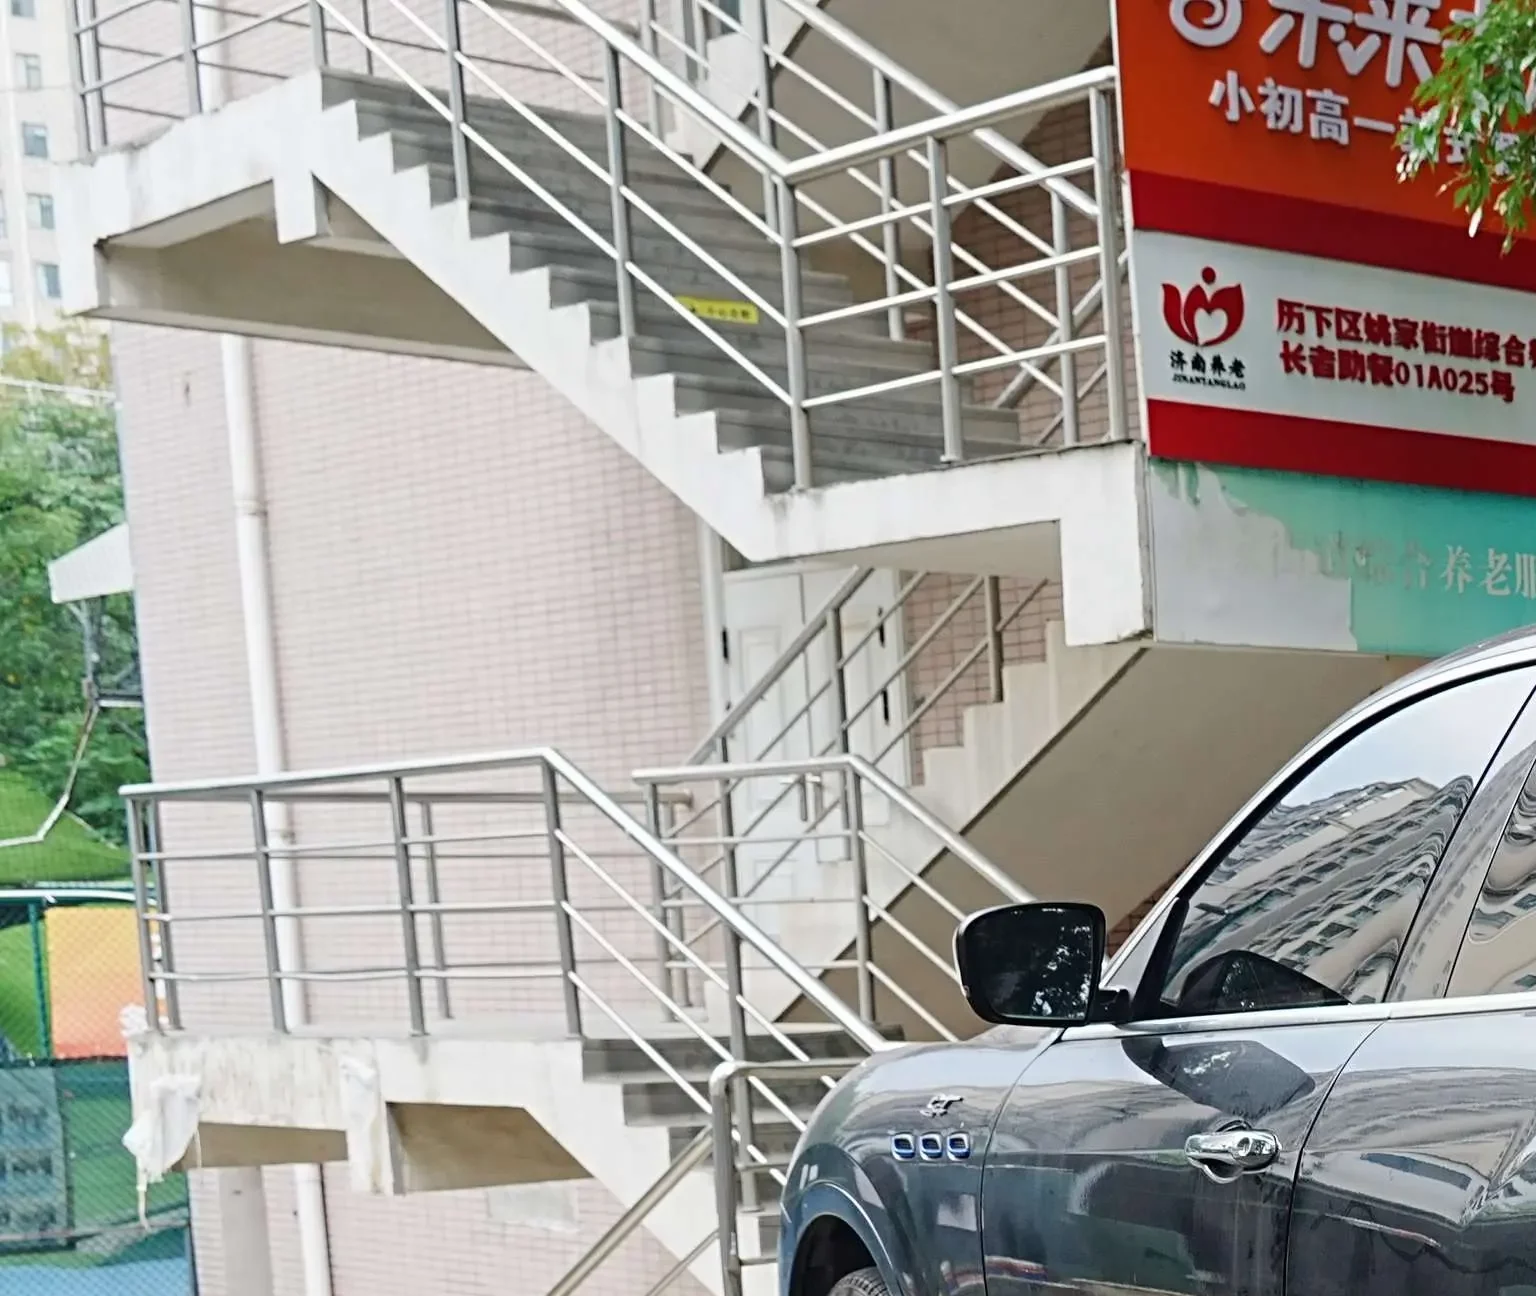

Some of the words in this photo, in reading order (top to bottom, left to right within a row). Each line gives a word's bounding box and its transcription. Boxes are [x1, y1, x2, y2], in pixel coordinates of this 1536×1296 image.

[1279, 340, 1516, 404] 长者助餐01A025号
